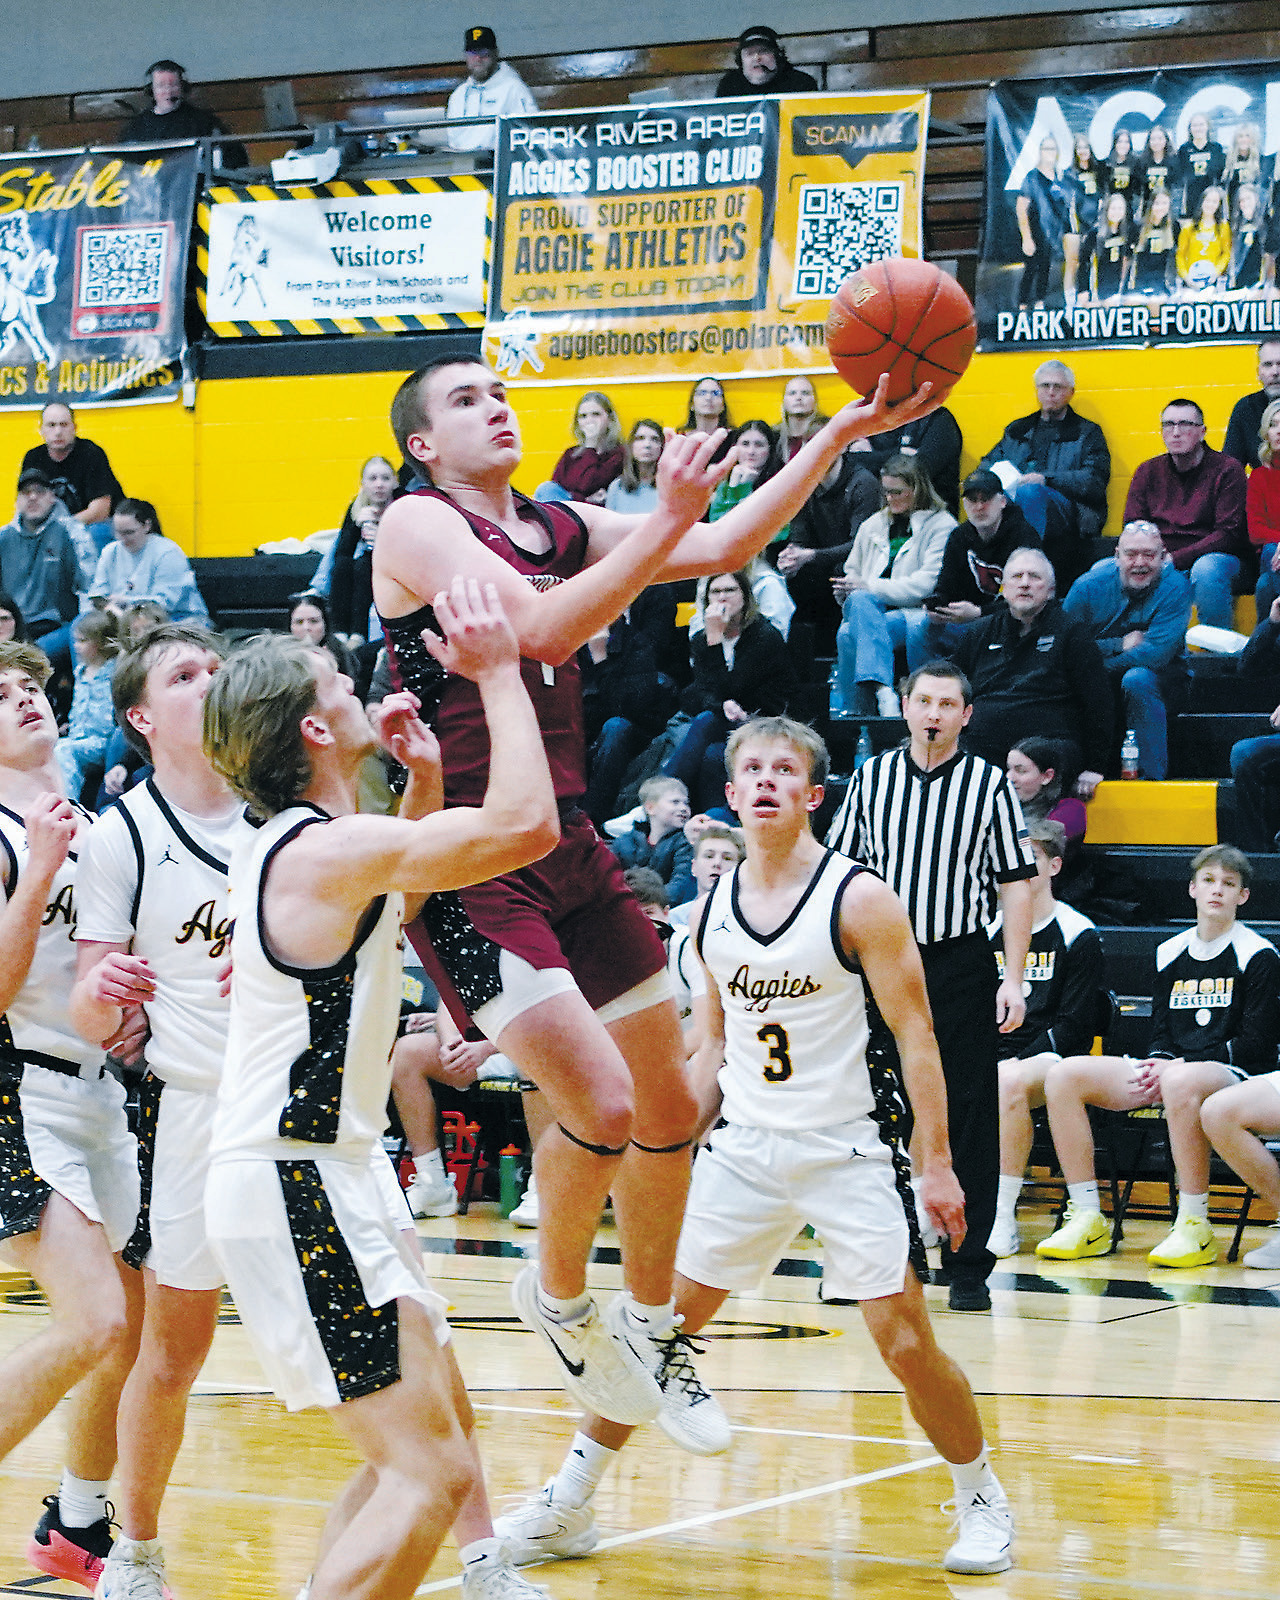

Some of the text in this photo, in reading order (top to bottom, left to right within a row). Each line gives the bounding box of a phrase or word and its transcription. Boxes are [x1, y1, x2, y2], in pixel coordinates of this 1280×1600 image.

[472, 29, 483, 41] P
[510, 112, 765, 151] PARK RIVER AREA
[805, 125, 865, 146] SCAN
[508, 145, 764, 196] AGGIES BOOSTER CLUB
[324, 210, 433, 233] Welcome
[519, 193, 747, 231] PROUD SUPPORTER OF
[330, 243, 425, 268] Visitors!
[514, 222, 748, 275] AGGIE ATHLETICS
[286, 281, 312, 291] From
[317, 280, 340, 290] Park
[345, 278, 371, 288] River
[402, 275, 442, 287] Schools
[447, 275, 469, 285] and
[511, 285, 557, 303] JOIN
[566, 282, 604, 300] THE
[610, 278, 667, 298] CLUB
[312, 292, 444, 309] The Aggies Booster Club
[998, 310, 1065, 342] PARK
[34, 361, 50, 394] &
[727, 964, 823, 1013] Aggies
[756, 1023, 793, 1083] 3
